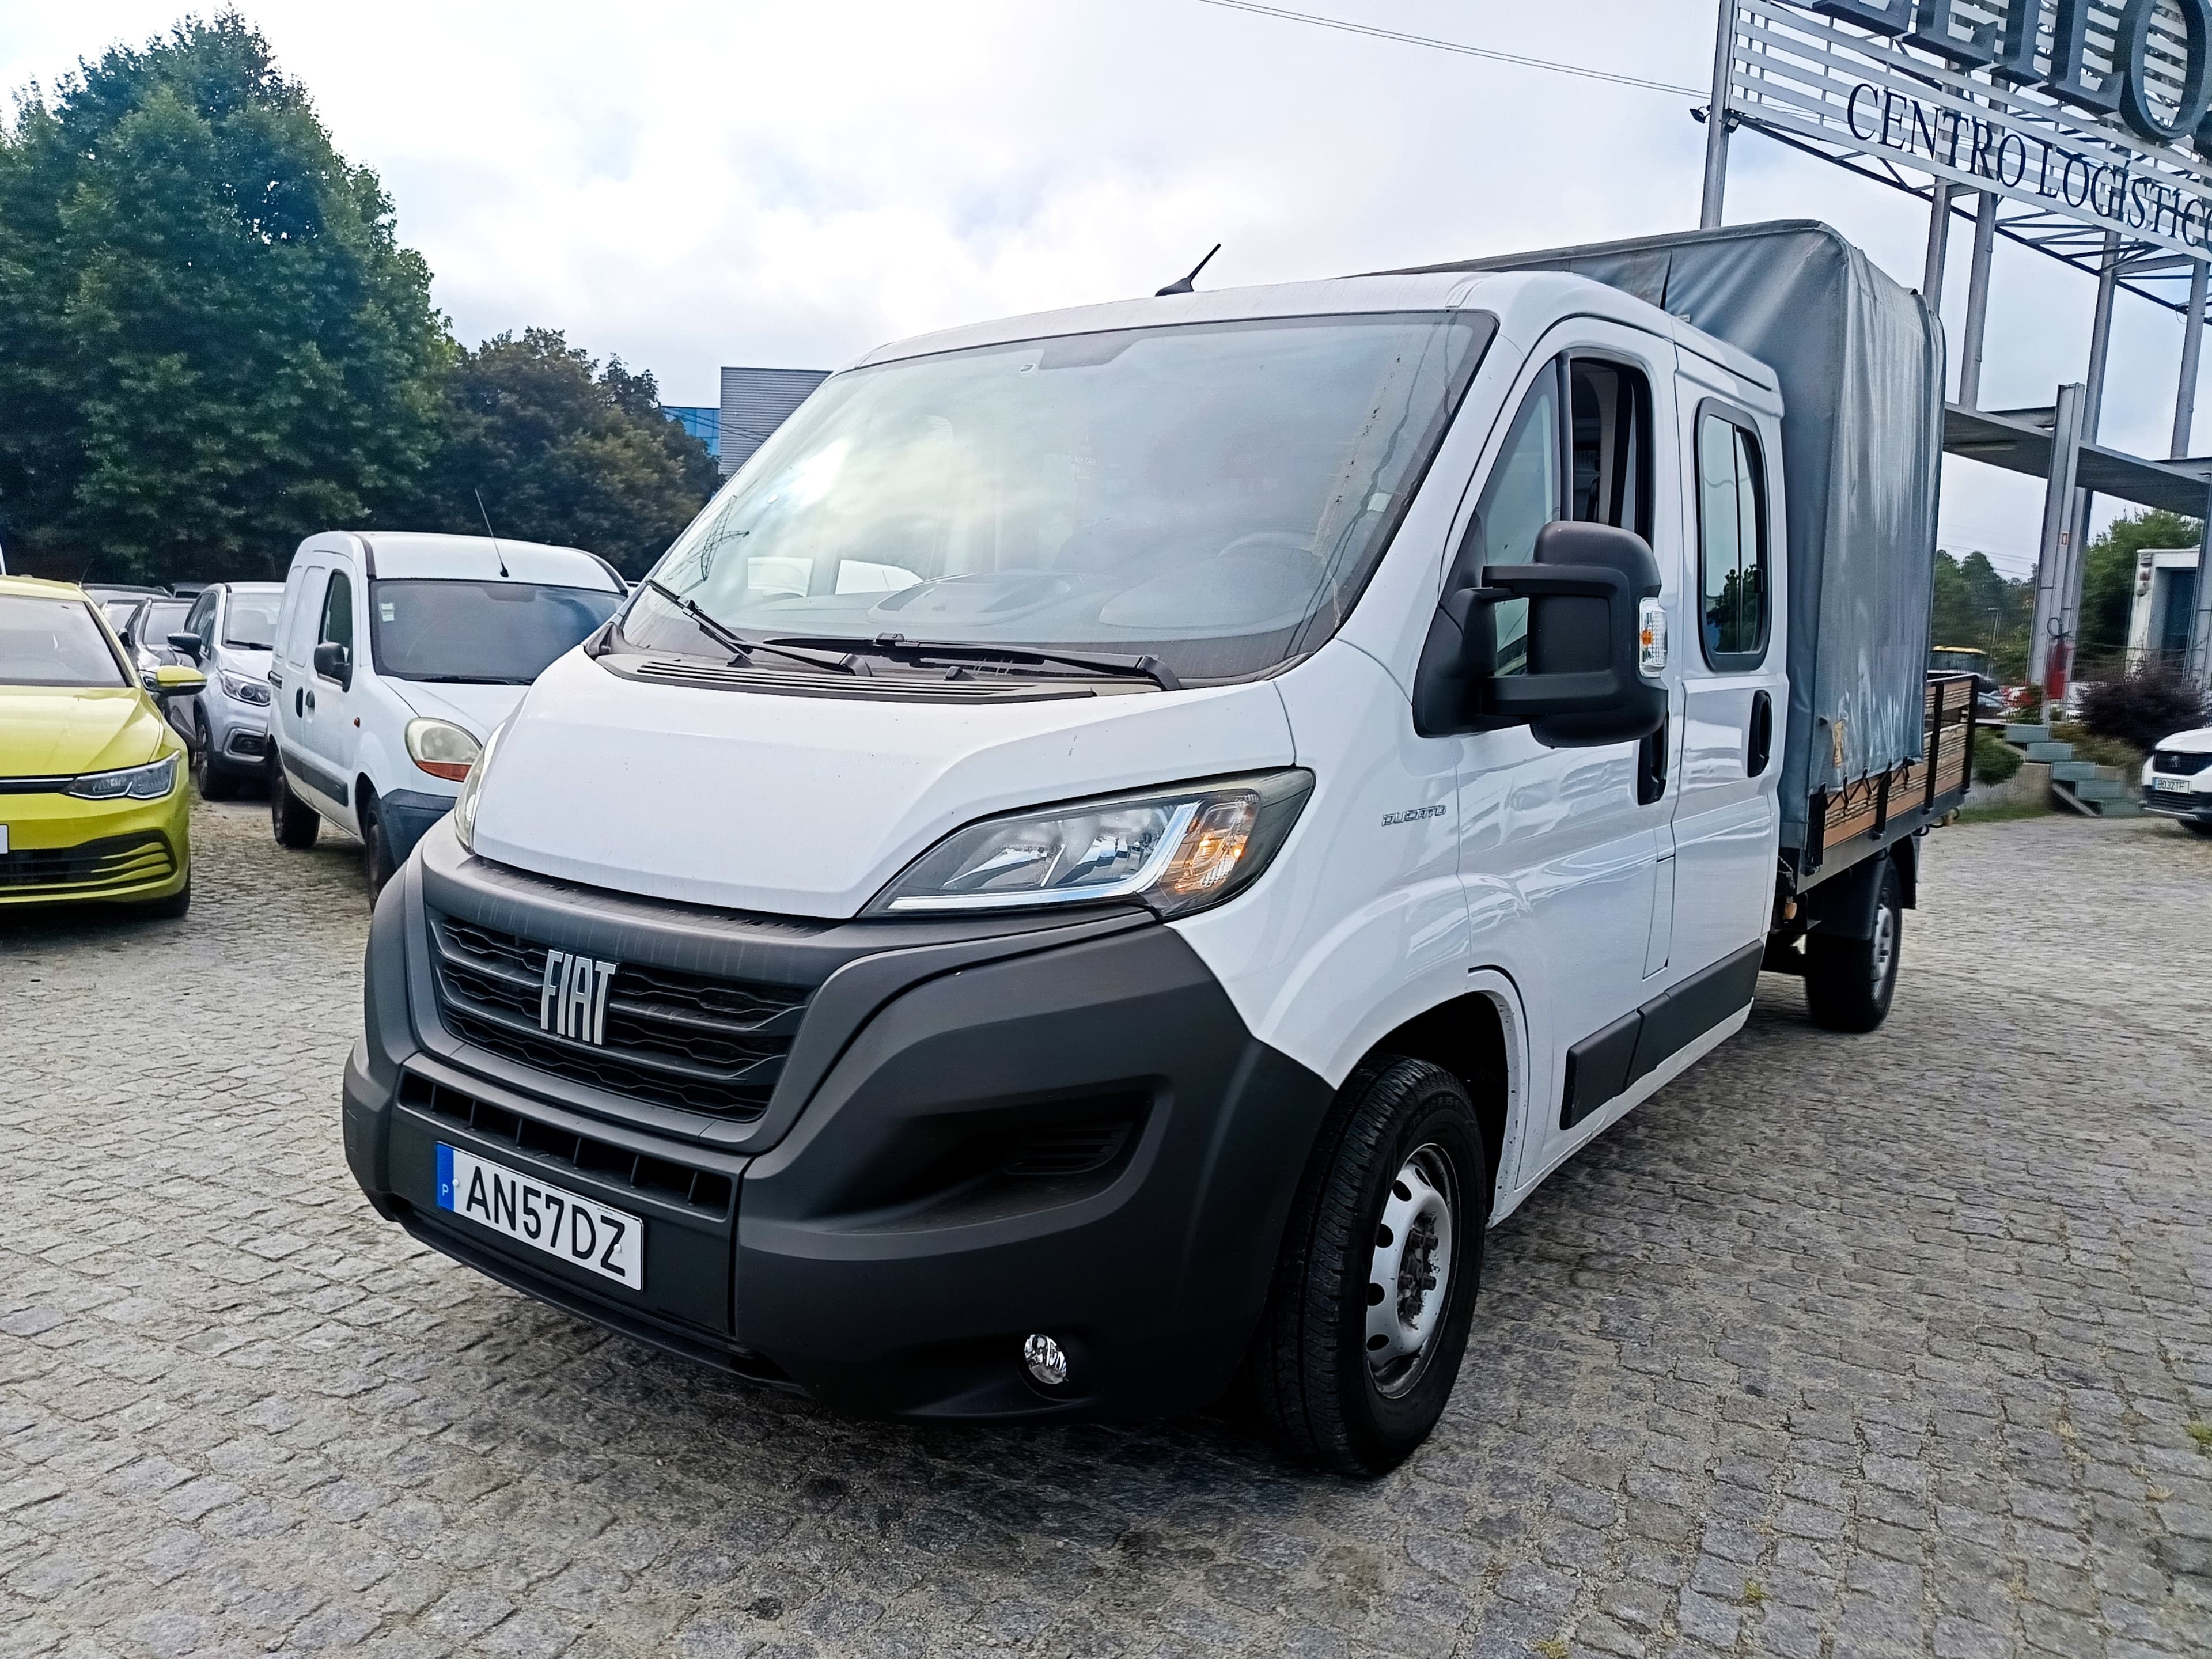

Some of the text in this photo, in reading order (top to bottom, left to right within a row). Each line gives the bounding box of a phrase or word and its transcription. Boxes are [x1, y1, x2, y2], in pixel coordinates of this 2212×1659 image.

[1847, 84, 2027, 188] CENTRO
[1381, 804, 1447, 827] DUCATO
[540, 949, 618, 1046] FIAT
[442, 1183, 449, 1196] P
[466, 1166, 626, 1277] AN57DZ
